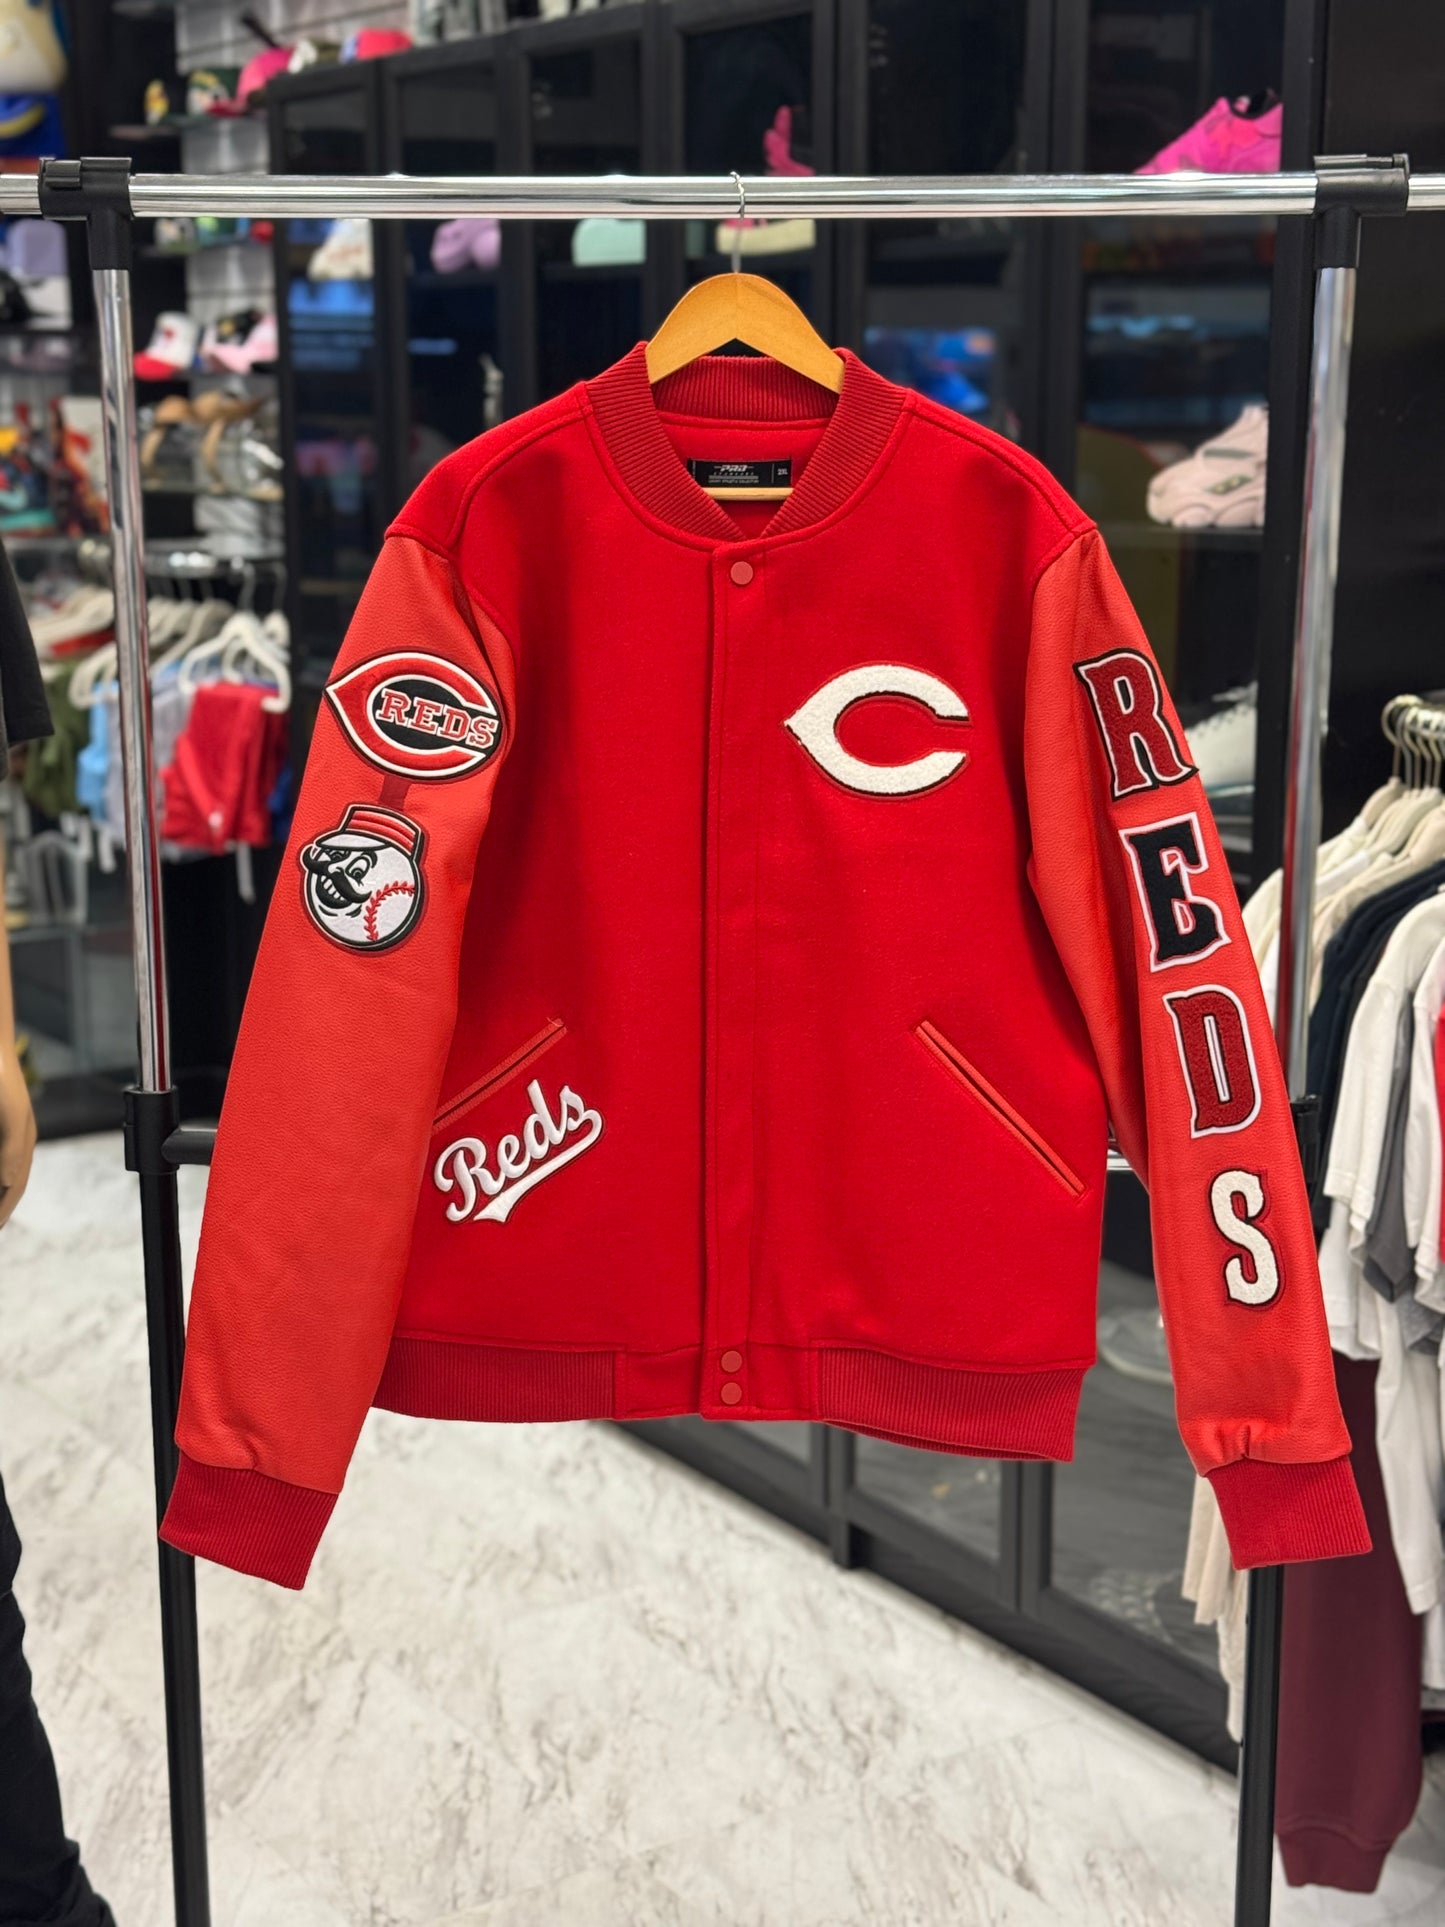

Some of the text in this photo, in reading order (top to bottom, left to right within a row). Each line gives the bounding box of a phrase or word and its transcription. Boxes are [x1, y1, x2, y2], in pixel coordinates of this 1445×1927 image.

[375, 687, 500, 751] REDS
[782, 662, 971, 799] C
[433, 1078, 604, 1224] Reds
